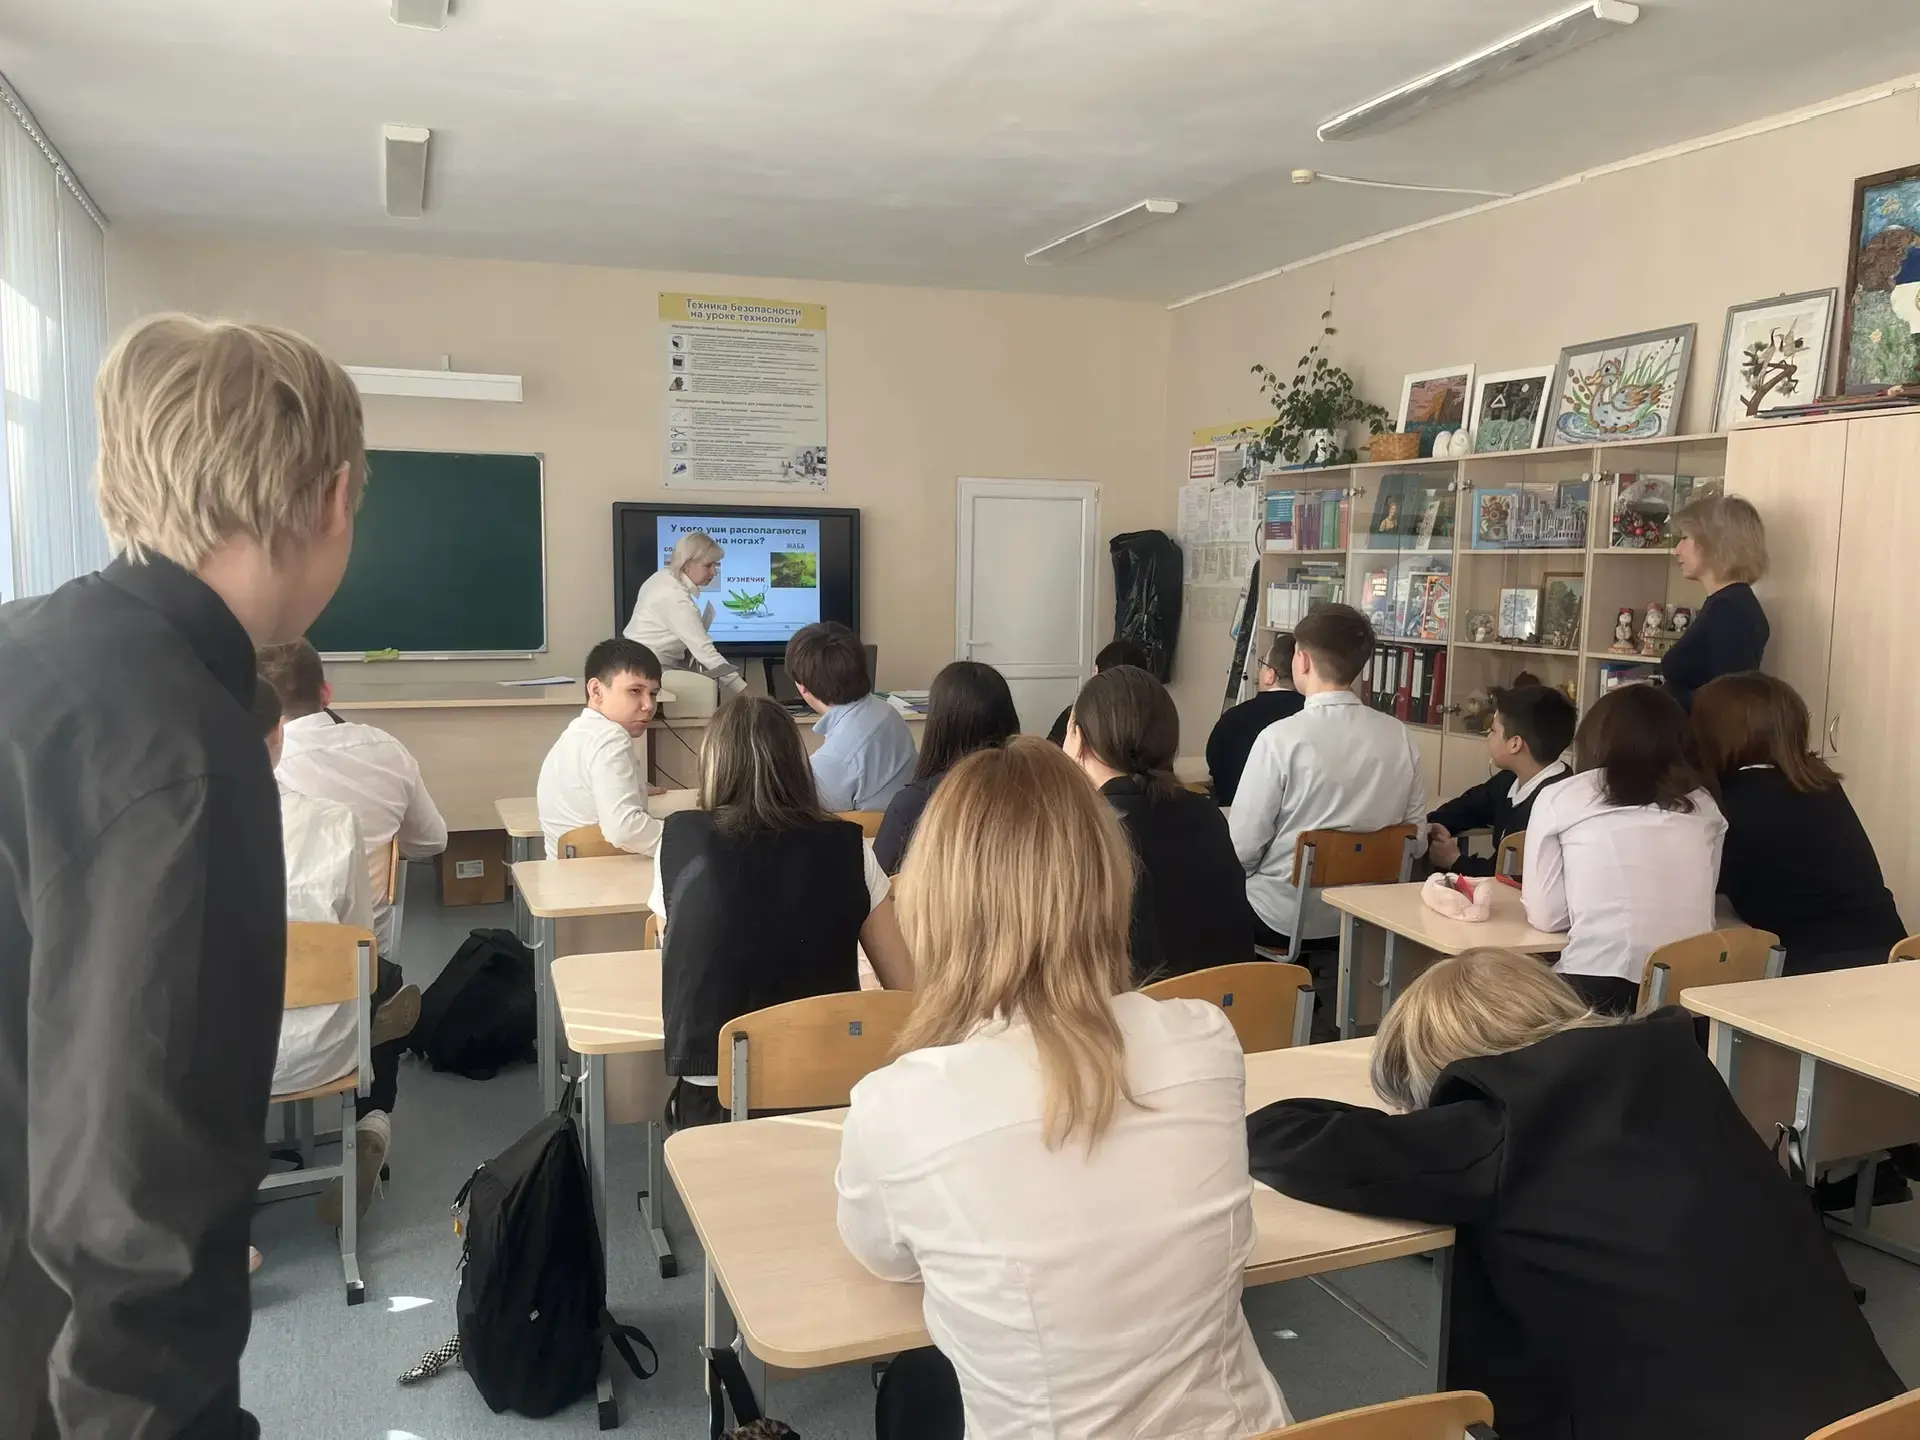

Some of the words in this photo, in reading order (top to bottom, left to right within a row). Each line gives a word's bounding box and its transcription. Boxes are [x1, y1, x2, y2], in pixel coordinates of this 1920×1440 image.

[686, 298, 728, 311] Техника
[730, 303, 802, 316] безопасности
[690, 310, 703, 318] на
[706, 311, 736, 321] уроке
[738, 314, 797, 325] технологии
[671, 524, 677, 532] У
[729, 527, 807, 535] располагаются
[730, 537, 765, 545] ногах?
